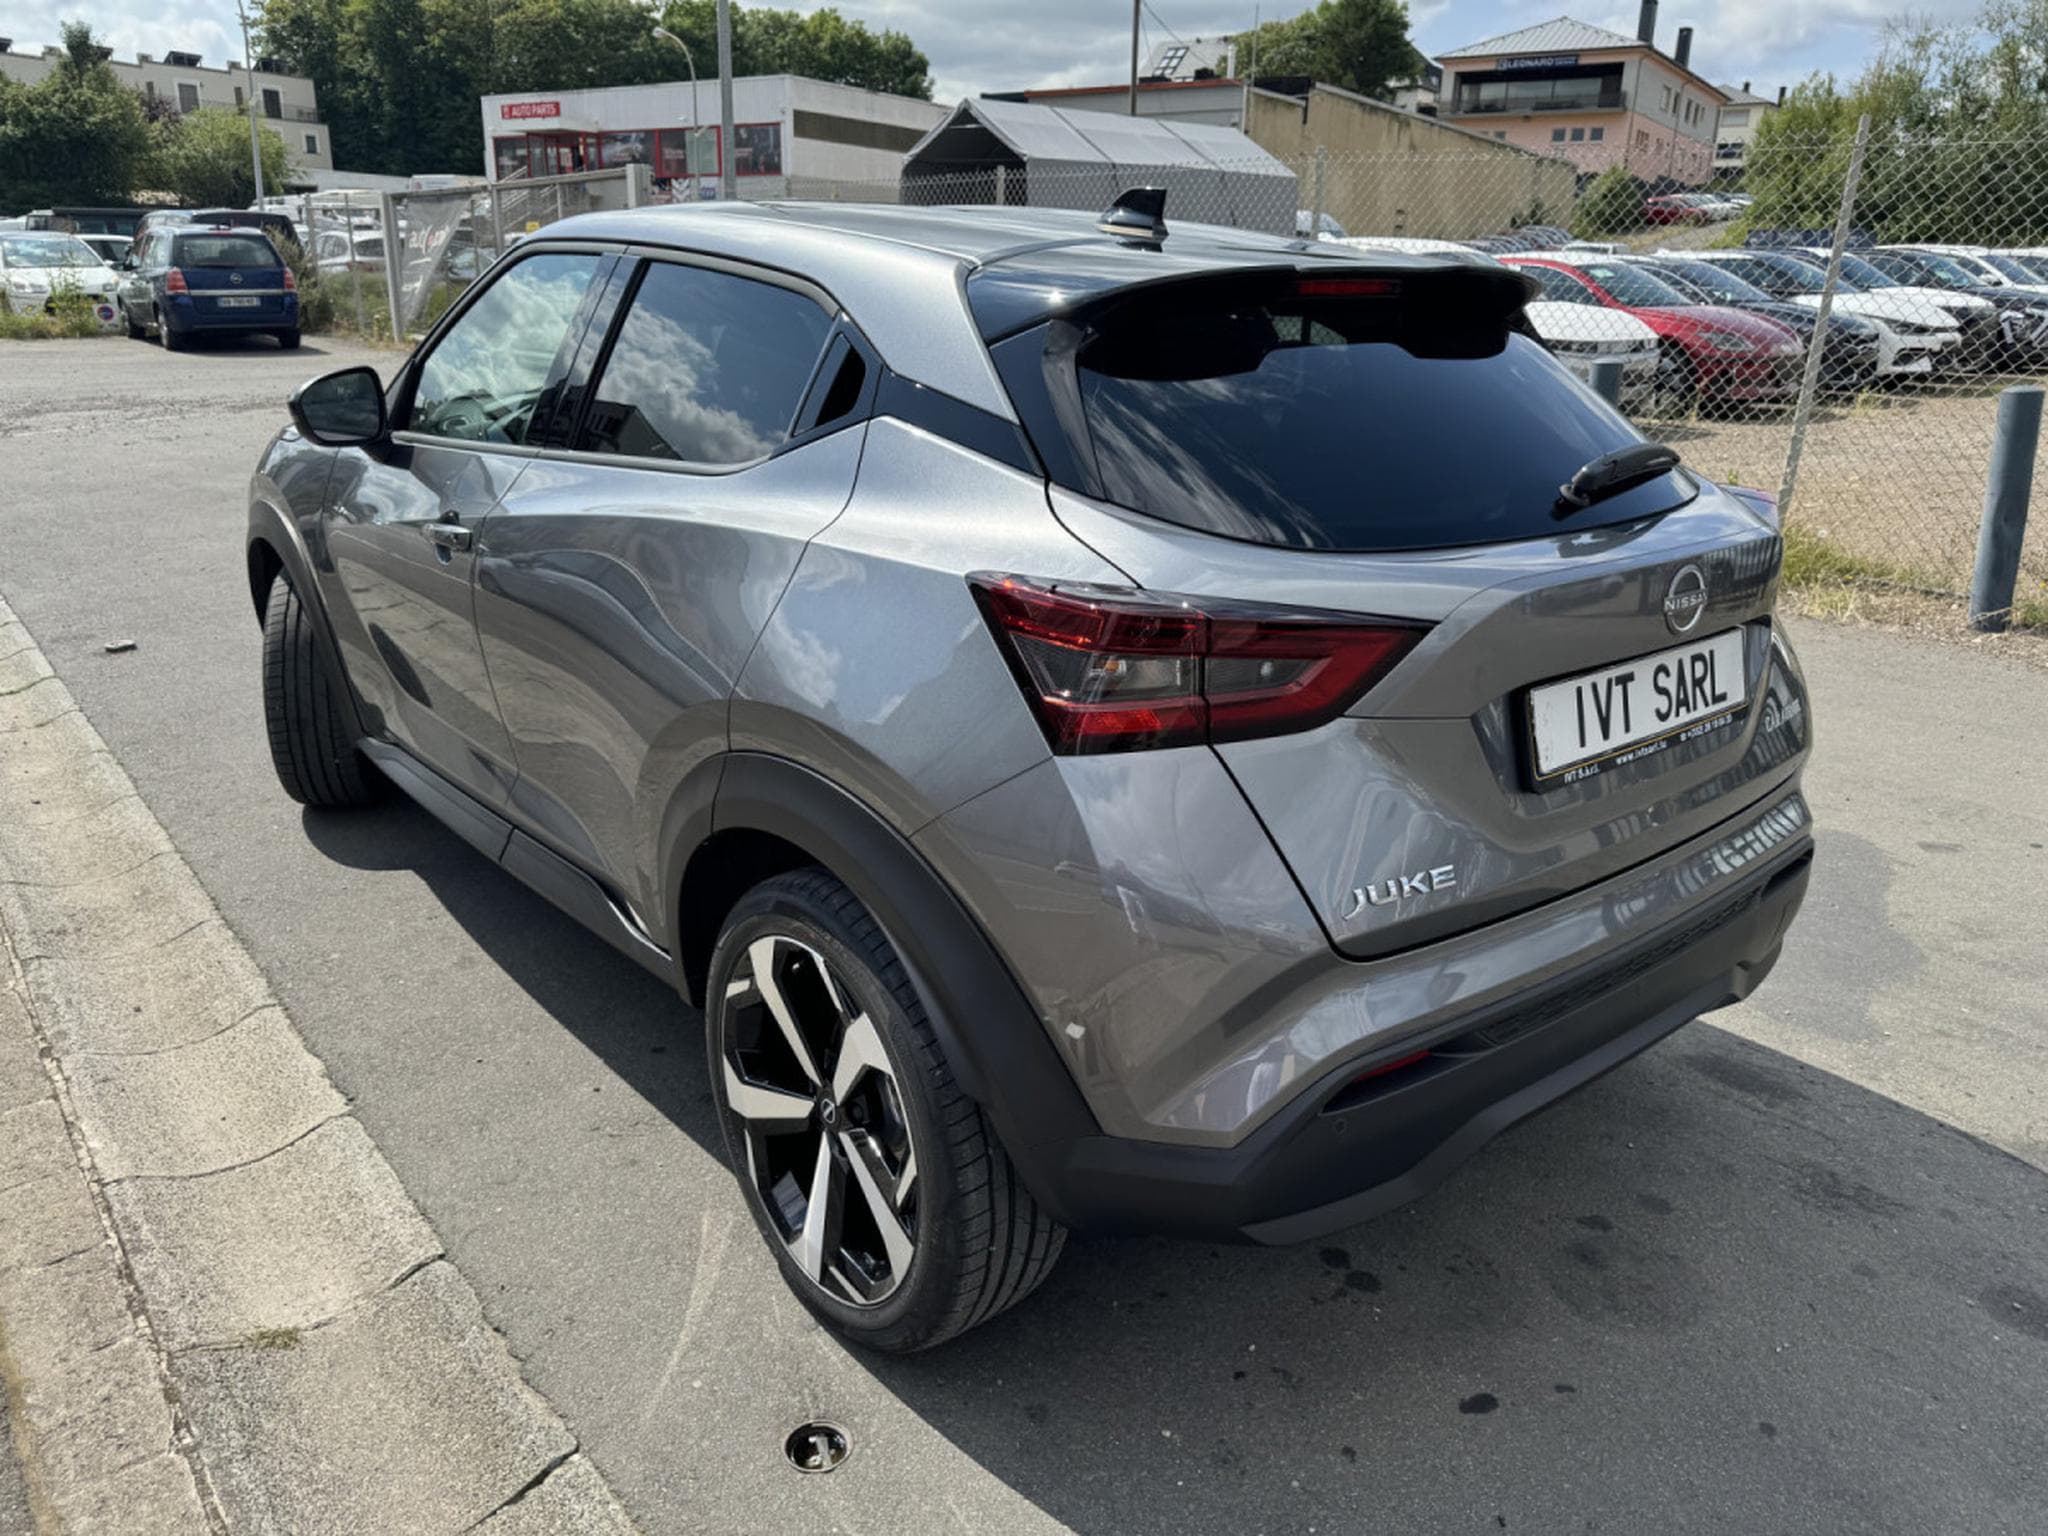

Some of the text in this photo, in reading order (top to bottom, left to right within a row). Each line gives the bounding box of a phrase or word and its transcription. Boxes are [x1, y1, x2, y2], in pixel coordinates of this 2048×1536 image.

[512, 103, 556, 117] AUTO PARTS
[1576, 649, 1728, 749] IVT SARL
[1342, 865, 1456, 920] JUKE
